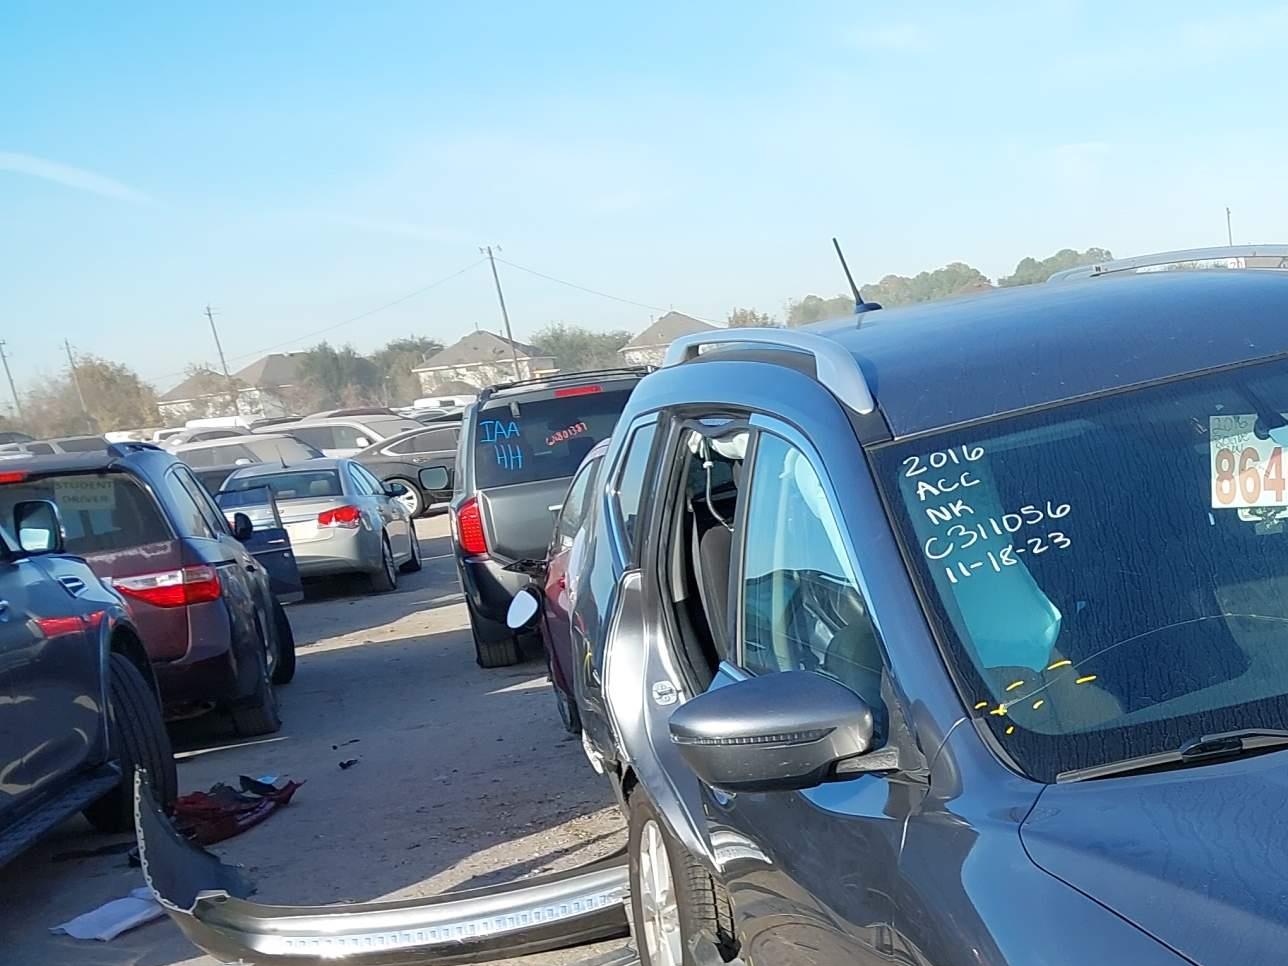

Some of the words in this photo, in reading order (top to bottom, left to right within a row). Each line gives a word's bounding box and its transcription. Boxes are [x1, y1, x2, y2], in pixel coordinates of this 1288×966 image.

[480, 420, 520, 443] IAA
[902, 444, 984, 477] 2016
[55, 481, 112, 489] STUDENT
[916, 472, 980, 501] ACC
[926, 500, 974, 525] NK
[925, 501, 1071, 559] C311056
[945, 532, 1071, 583] 11-18-23
